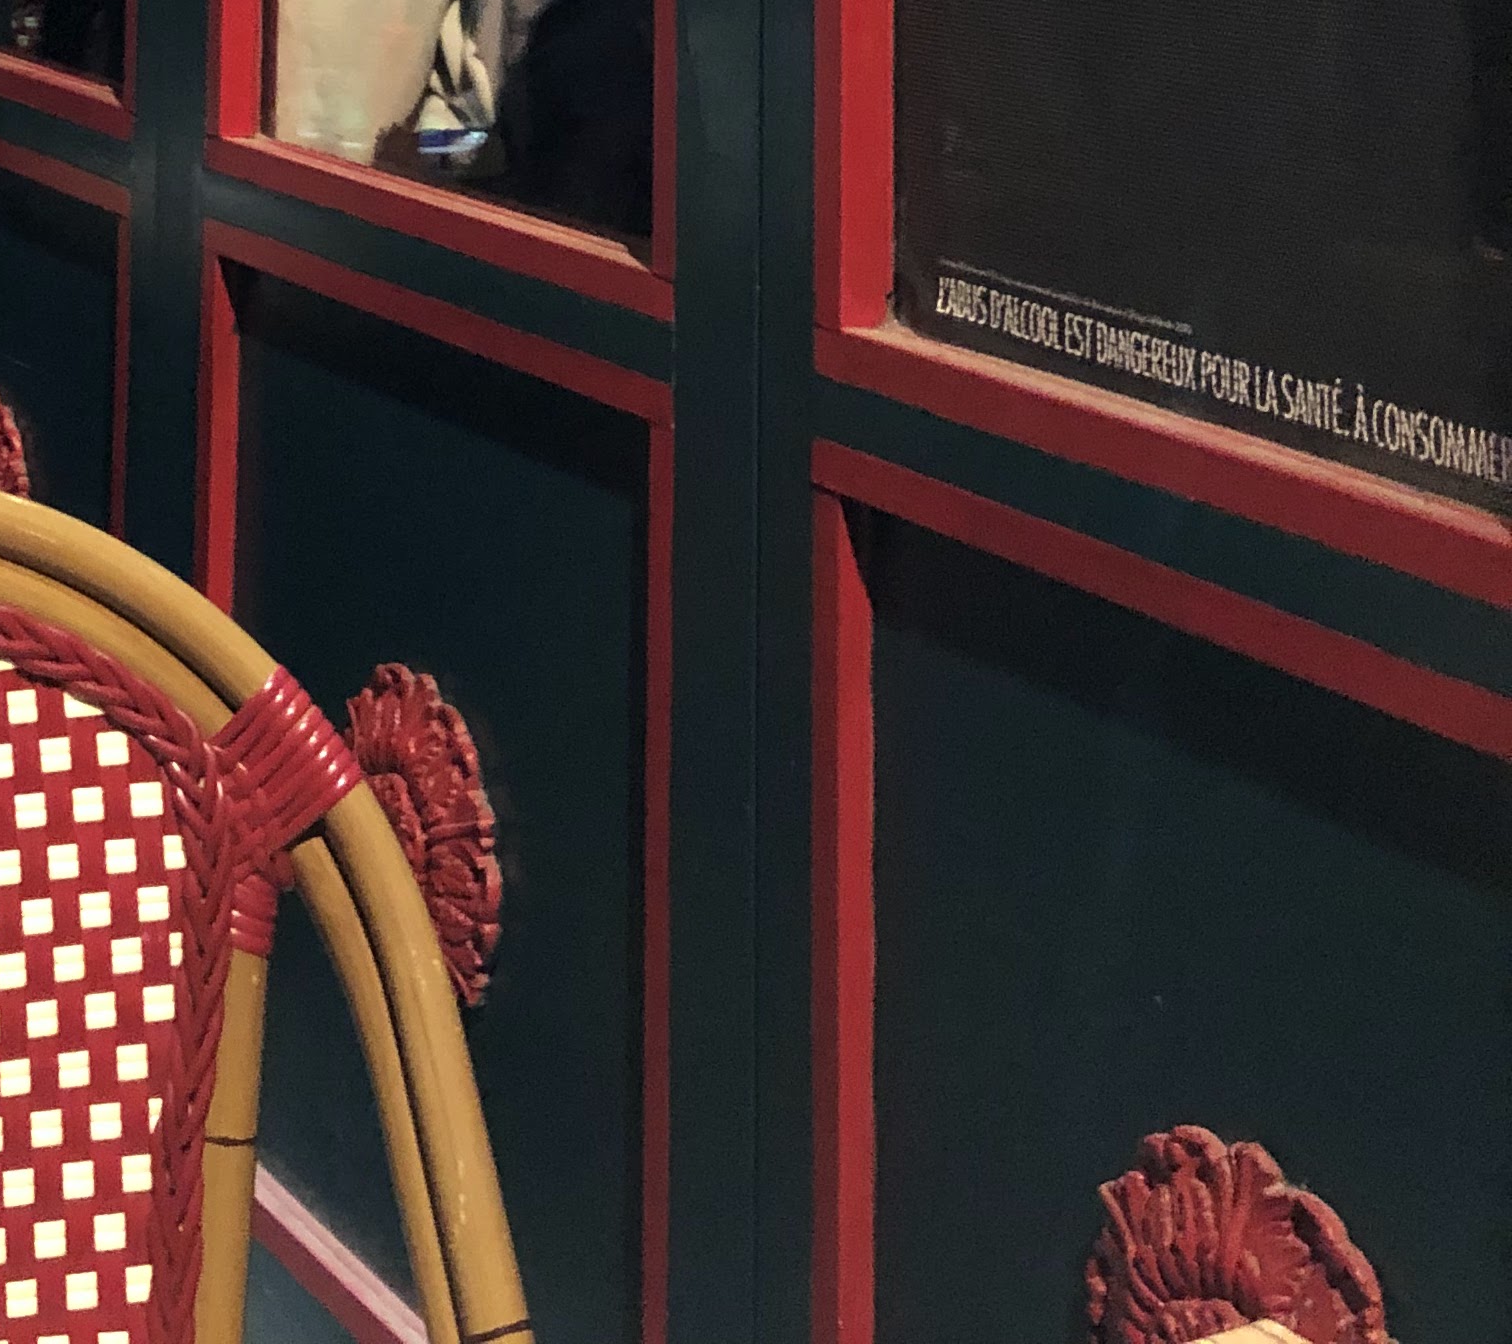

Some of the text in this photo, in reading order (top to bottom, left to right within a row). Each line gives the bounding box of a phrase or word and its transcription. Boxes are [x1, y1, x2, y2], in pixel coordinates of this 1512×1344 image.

[1064, 313, 1094, 359] EST
[1096, 321, 1197, 391] DANGEREUX
[1200, 349, 1251, 408] POUR
[1254, 365, 1279, 416] LA
